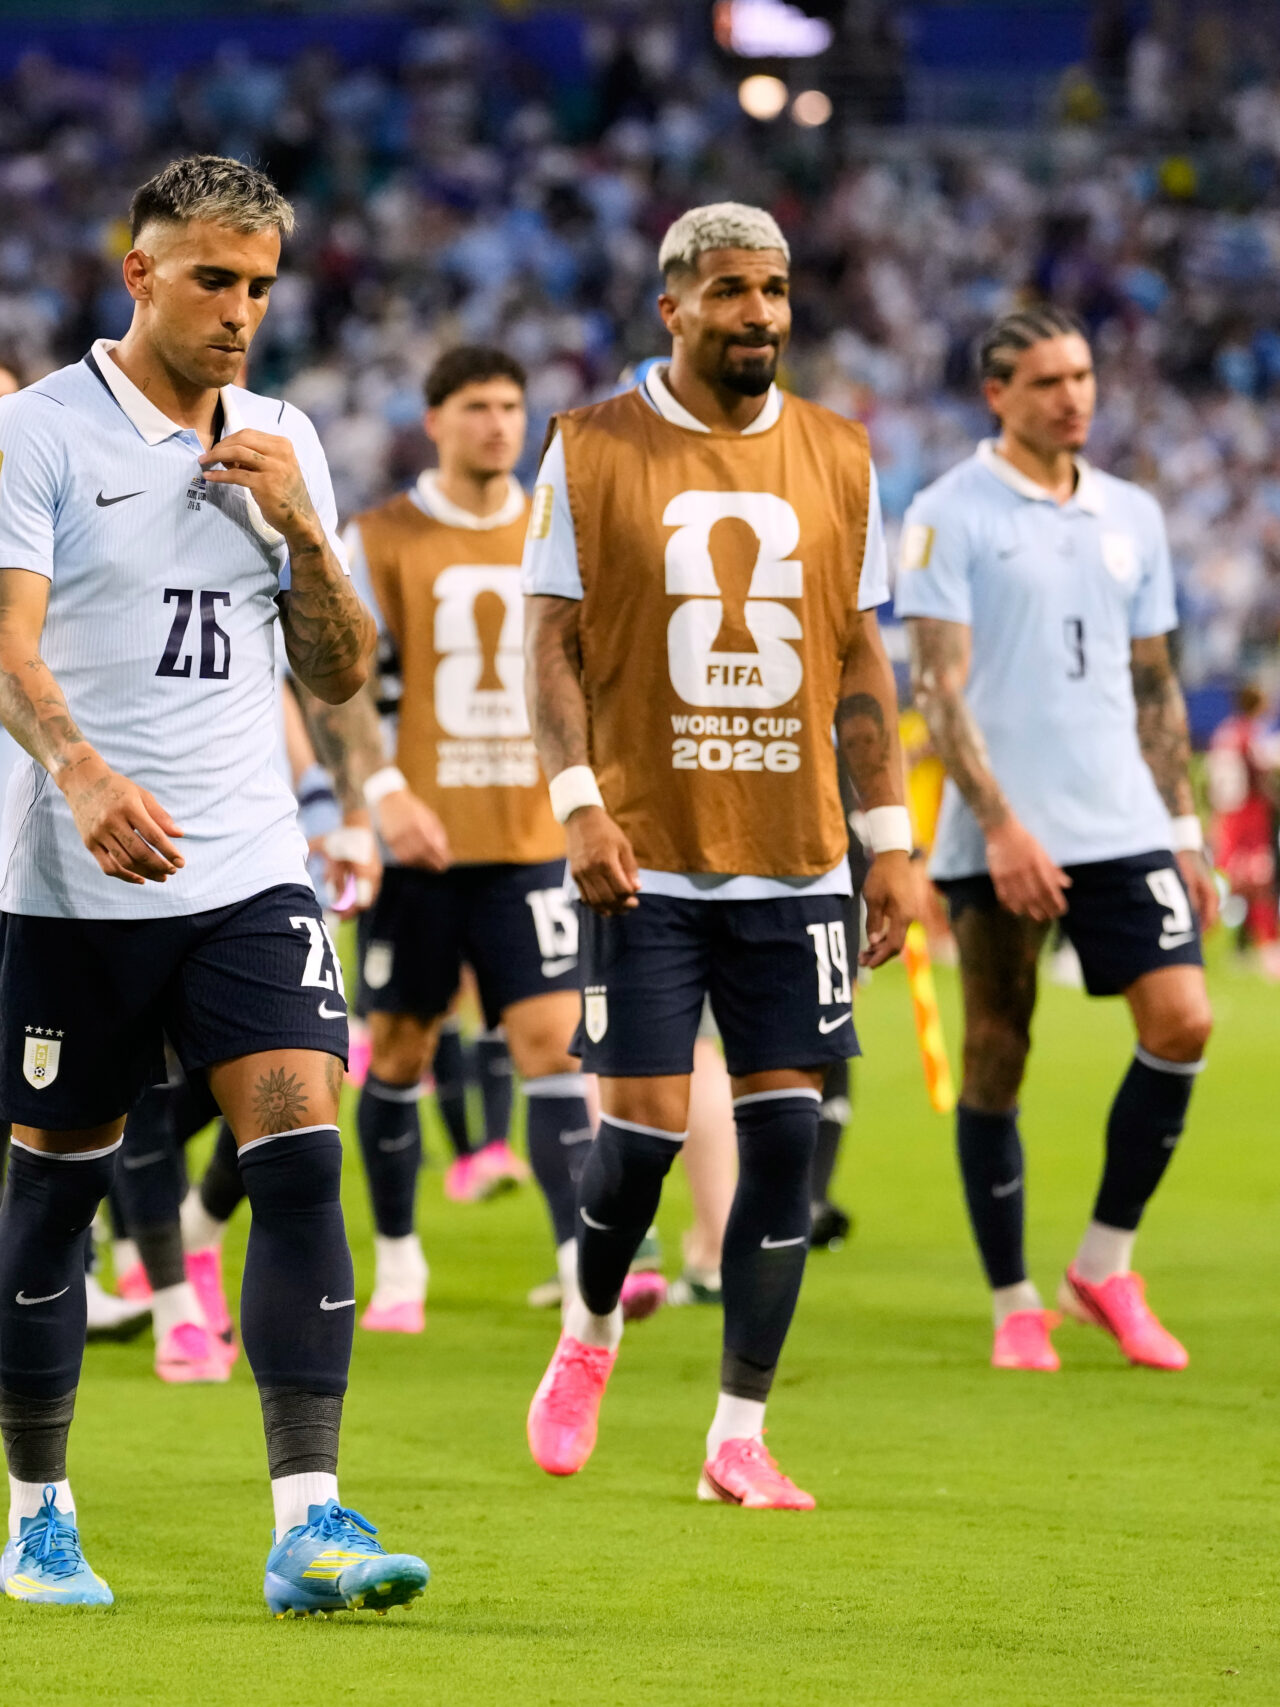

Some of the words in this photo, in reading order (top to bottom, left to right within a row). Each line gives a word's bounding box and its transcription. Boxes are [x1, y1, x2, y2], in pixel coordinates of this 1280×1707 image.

[155, 588, 231, 679] 26
[706, 665, 763, 687] FIFA
[671, 715, 750, 736] WORLD
[753, 717, 802, 737] CUP
[671, 738, 801, 773] 2026
[525, 888, 579, 958] 15
[1145, 867, 1192, 933] 9
[806, 921, 852, 1005] 19
